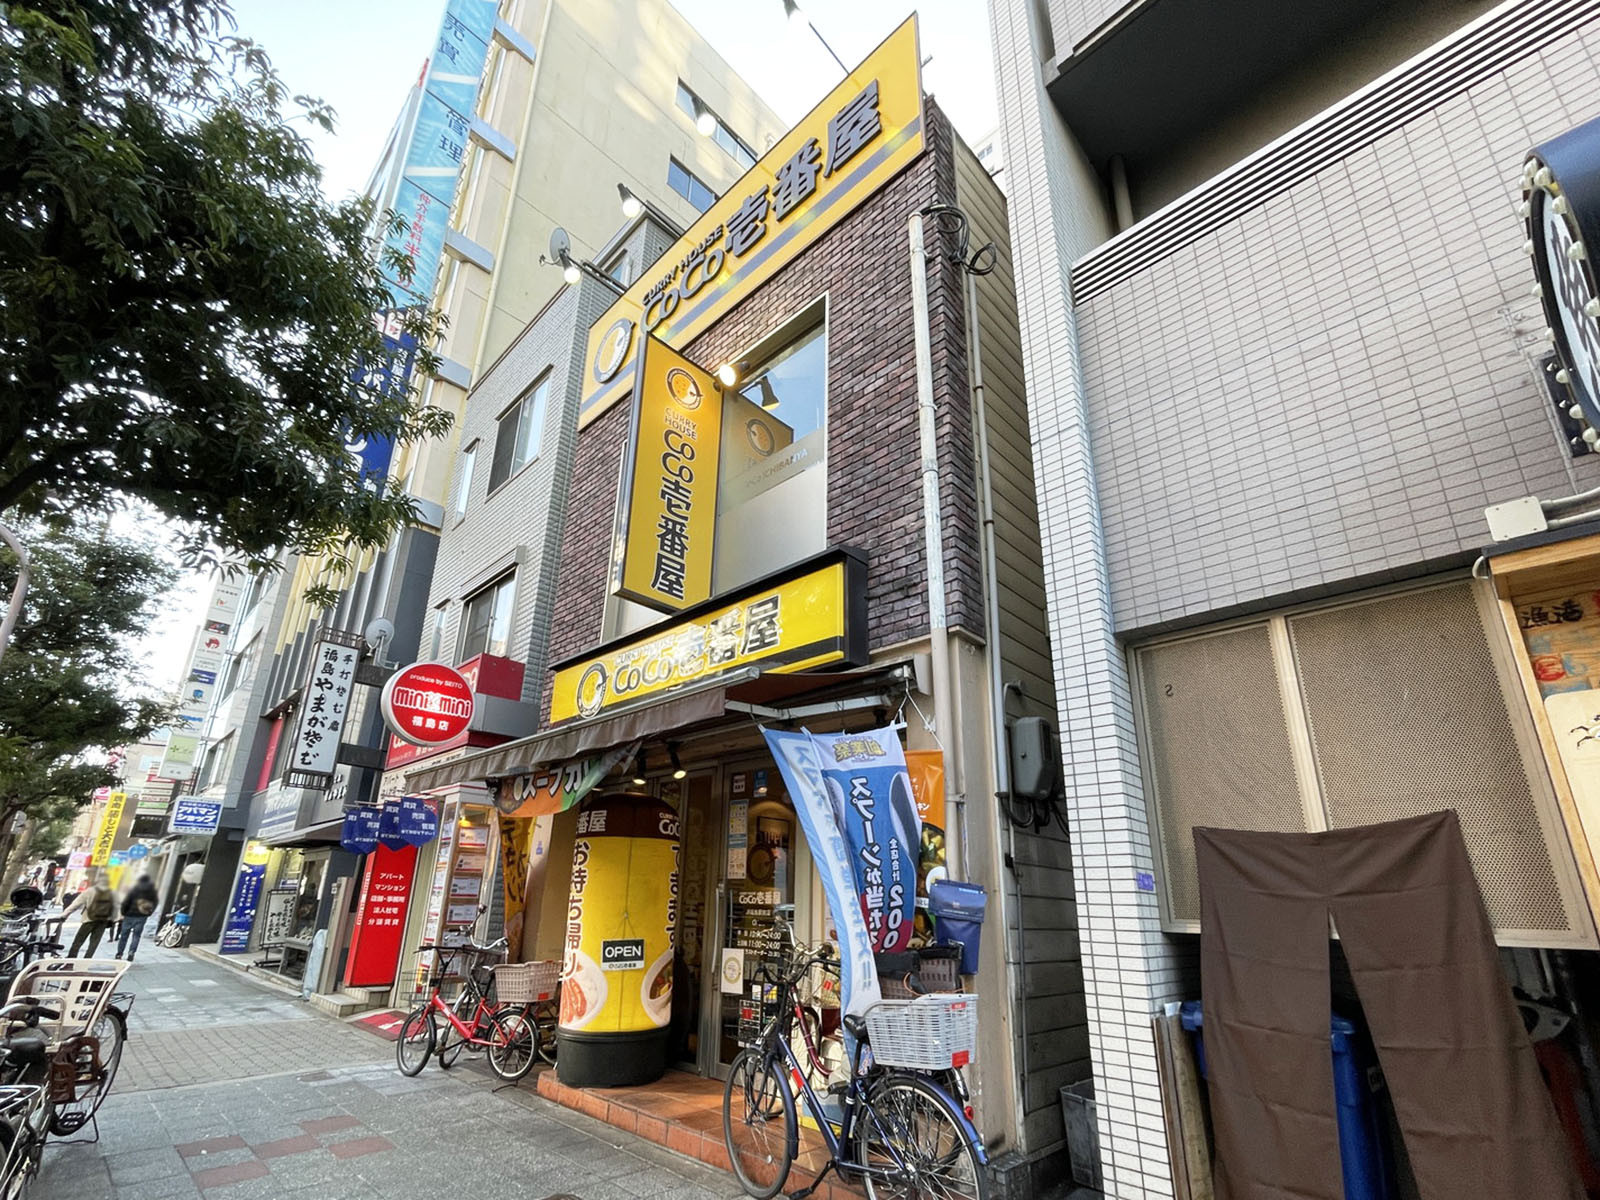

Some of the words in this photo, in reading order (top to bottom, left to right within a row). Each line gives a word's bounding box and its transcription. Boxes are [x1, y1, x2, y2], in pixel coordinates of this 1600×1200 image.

[438, 15, 465, 65] 売買
[438, 110, 468, 164] 管理
[641, 79, 882, 334] CoCo壱番屋
[642, 264, 677, 306] CURRY
[680, 225, 724, 271] HOUSE
[663, 417, 697, 440] HOUSE
[664, 407, 697, 429] CURRY
[409, 674, 435, 683] produce
[412, 716, 449, 731] 福島店
[176, 814, 216, 823] ショップ
[178, 806, 218, 815] アパマン
[605, 945, 641, 957] OPEN
